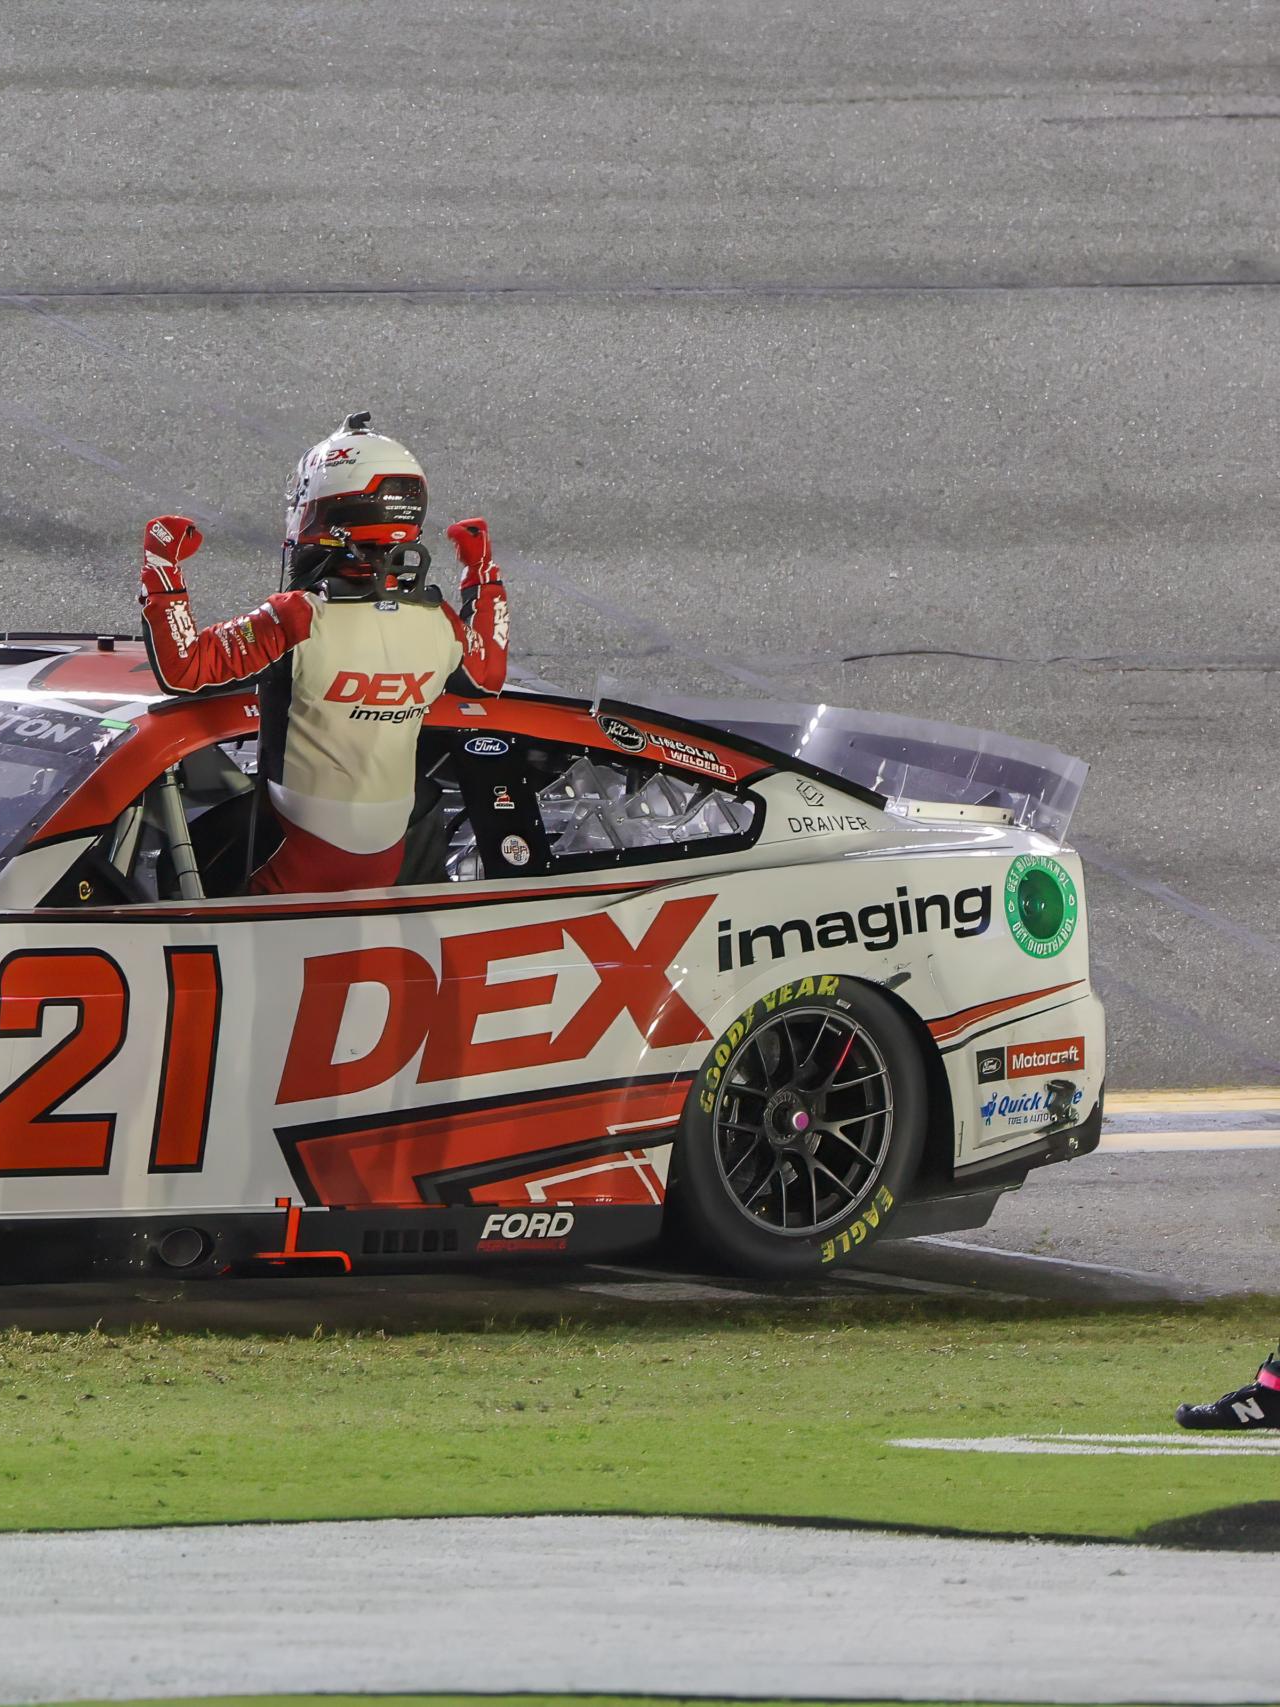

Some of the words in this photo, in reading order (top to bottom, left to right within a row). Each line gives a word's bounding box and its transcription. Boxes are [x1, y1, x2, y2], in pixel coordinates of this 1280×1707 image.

[323, 671, 435, 706] DEX
[474, 740, 501, 752] Ford
[649, 734, 716, 762] LINCOLN
[670, 751, 727, 775] WELDERS
[788, 816, 871, 833] DRAIVER
[718, 885, 992, 973] imaging
[276, 895, 718, 1105] DEX
[1012, 1046, 1080, 1070] Motorcraft
[998, 1091, 1042, 1116] Quick
[1043, 1088, 1082, 1109] Le
[480, 1212, 575, 1239] FORD
[821, 1185, 895, 1263] EAGLE
[1231, 1397, 1265, 1423] N
